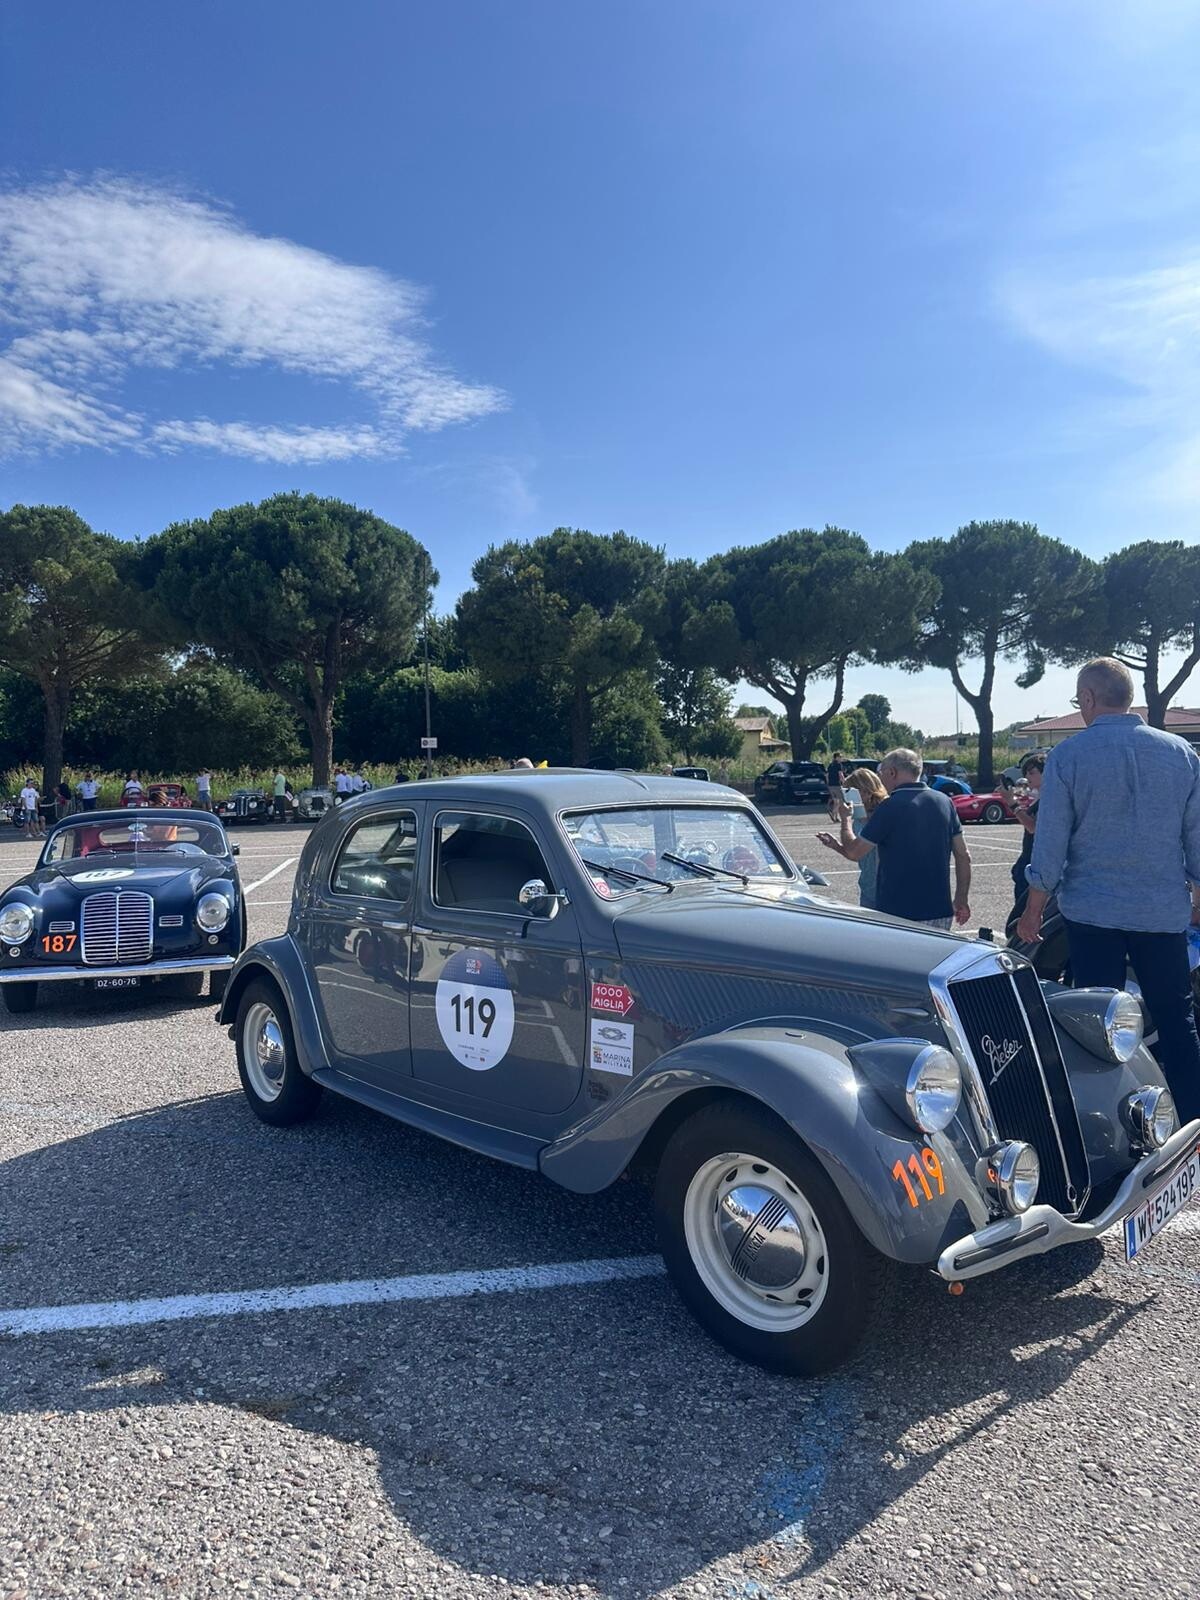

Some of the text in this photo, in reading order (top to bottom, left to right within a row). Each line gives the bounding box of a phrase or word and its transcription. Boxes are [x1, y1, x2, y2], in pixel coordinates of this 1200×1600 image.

[42, 934, 77, 953] 187
[97, 978, 137, 988] DZ-60-76
[596, 986, 623, 998] 1000
[593, 997, 624, 1010] MIGLIA
[451, 993, 496, 1038] 119
[603, 1052, 631, 1063] MARINA
[892, 1147, 945, 1208] 119
[1138, 1211, 1147, 1242] W
